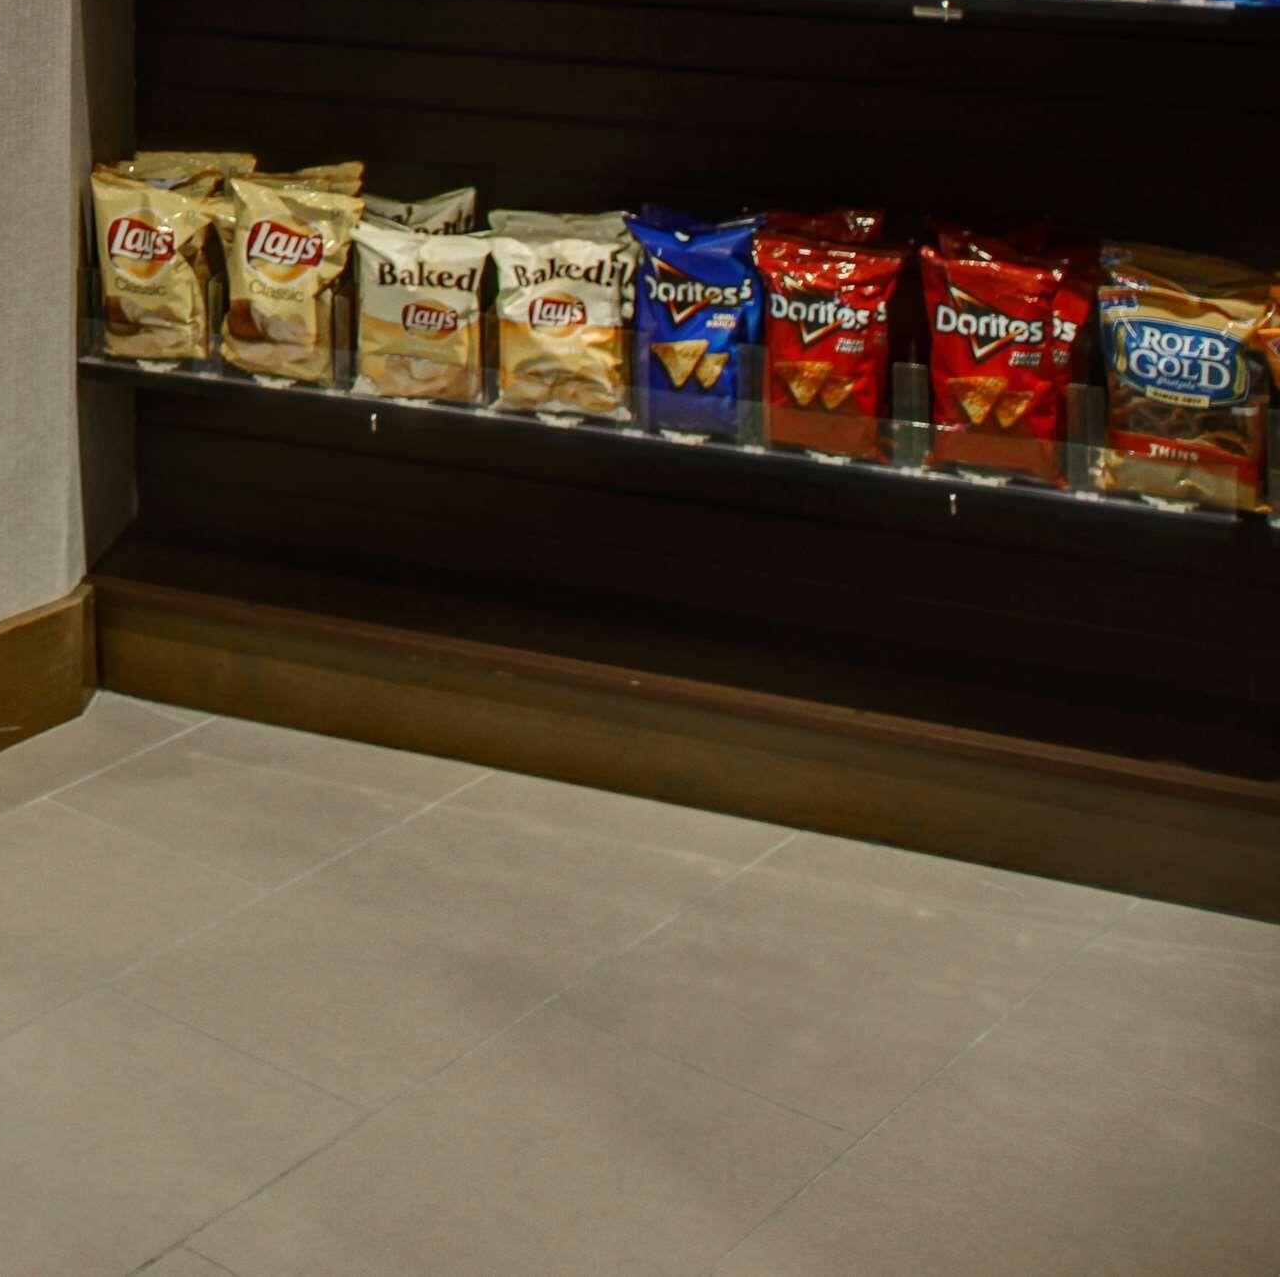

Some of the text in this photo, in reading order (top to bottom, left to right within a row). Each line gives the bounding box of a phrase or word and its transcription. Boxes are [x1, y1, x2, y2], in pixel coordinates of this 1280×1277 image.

[114, 278, 167, 297] Classic
[249, 279, 305, 303] Classic
[377, 261, 479, 293] Baked
[770, 293, 871, 330] Doritos
[936, 303, 1043, 343] Doritos
[1141, 325, 1227, 362] ROLD
[1129, 348, 1232, 391] GOLD
[1148, 443, 1199, 462] THINS
